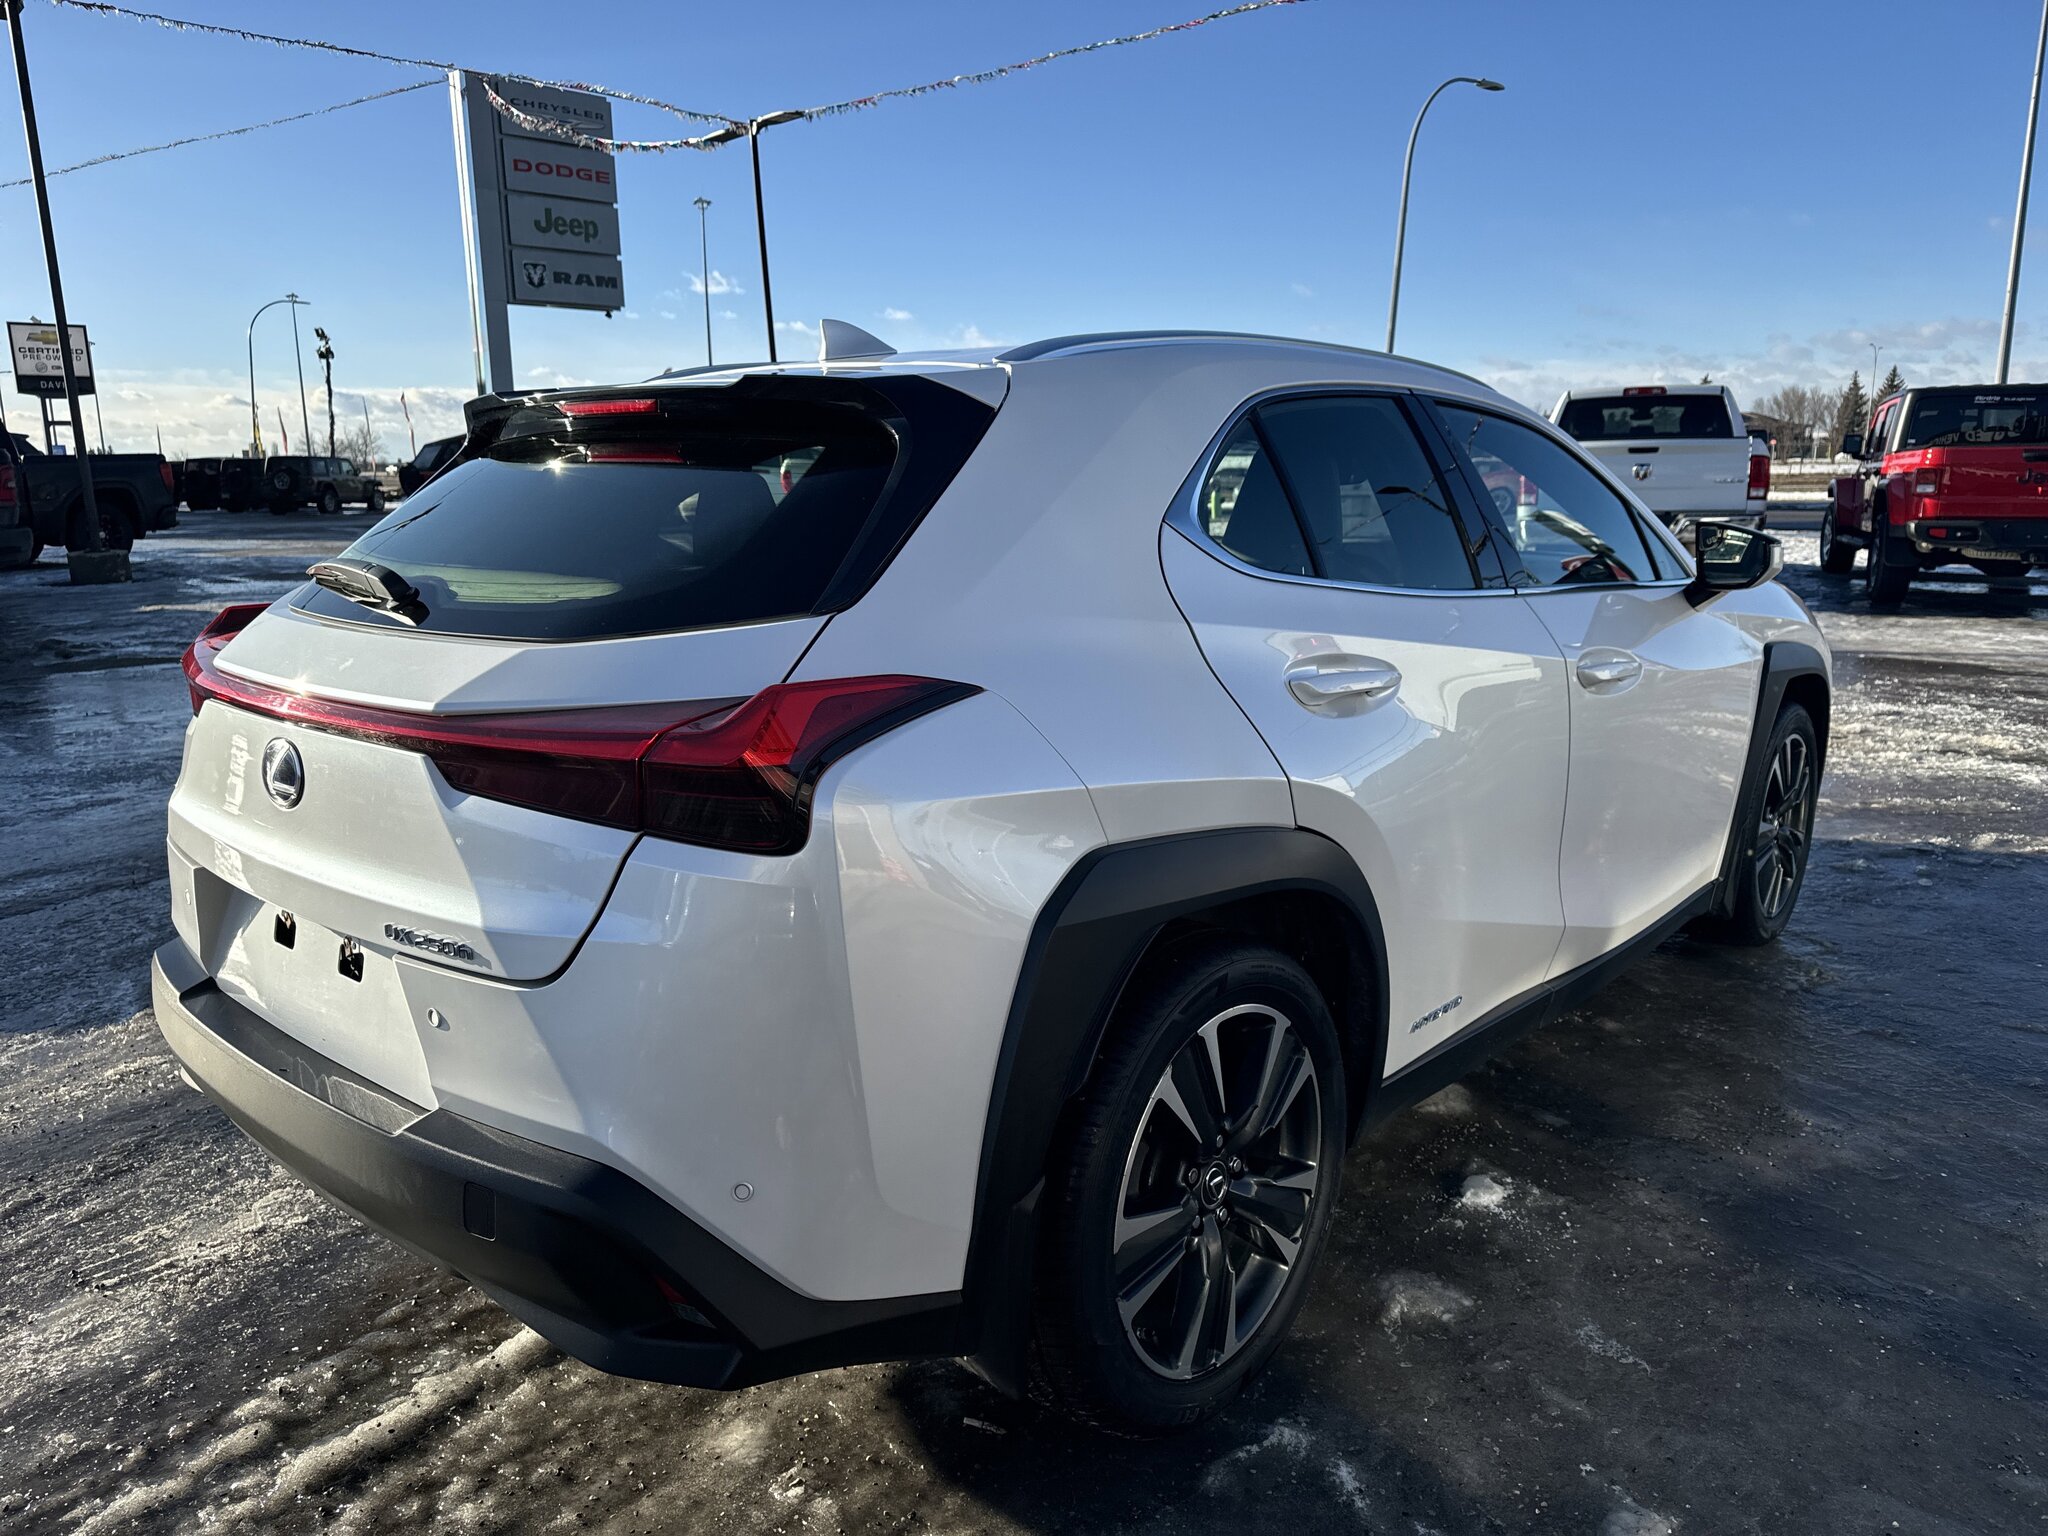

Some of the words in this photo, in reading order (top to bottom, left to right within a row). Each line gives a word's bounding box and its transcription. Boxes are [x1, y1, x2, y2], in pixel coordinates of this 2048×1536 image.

[510, 97, 604, 120] CHRYSLER
[512, 158, 611, 184] DODGE
[534, 207, 599, 242] Jeep
[553, 271, 618, 289] RAM
